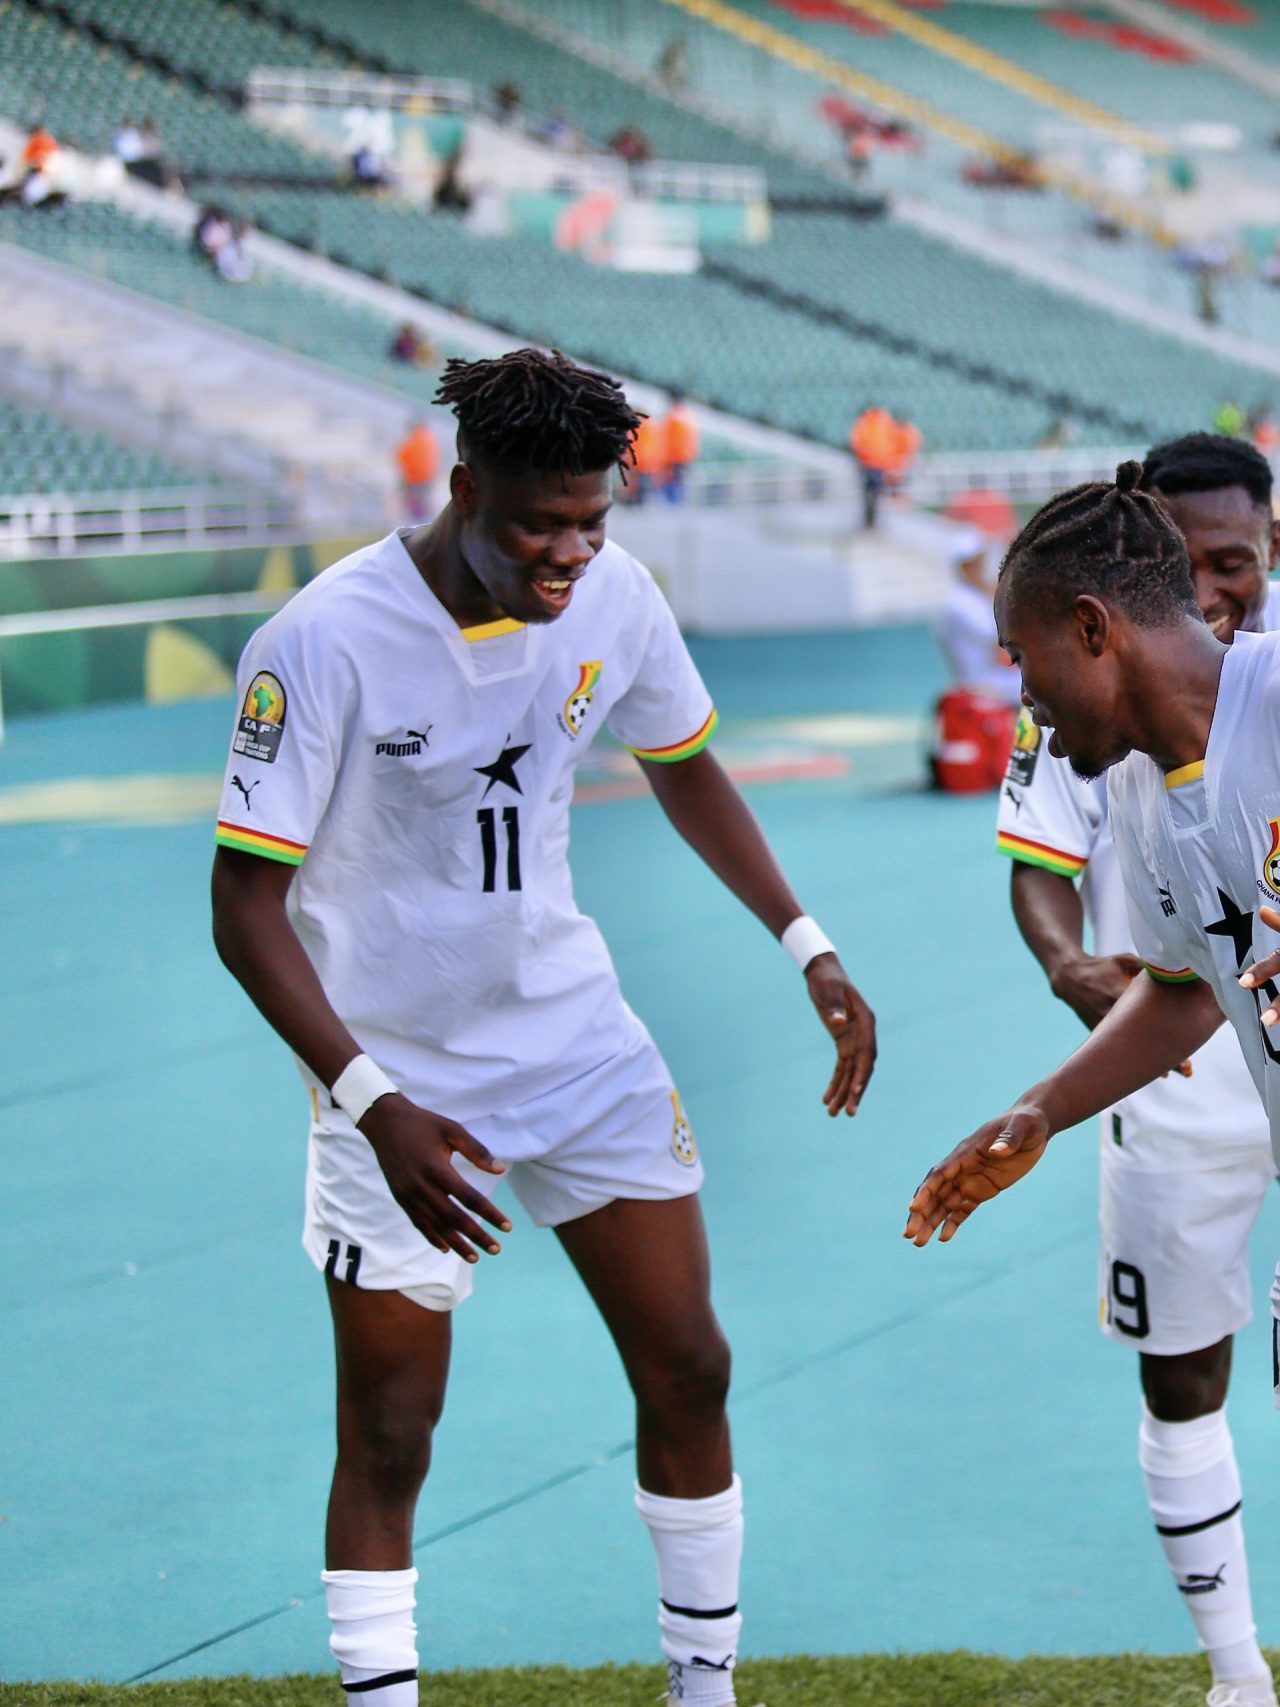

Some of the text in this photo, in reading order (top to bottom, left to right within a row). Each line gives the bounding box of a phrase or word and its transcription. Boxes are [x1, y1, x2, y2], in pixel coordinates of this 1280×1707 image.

[376, 740, 421, 758] PUMA
[477, 806, 522, 893] 11
[1256, 880, 1275, 901] GHANA
[324, 1238, 362, 1285] 11
[1106, 1253, 1150, 1340] 9
